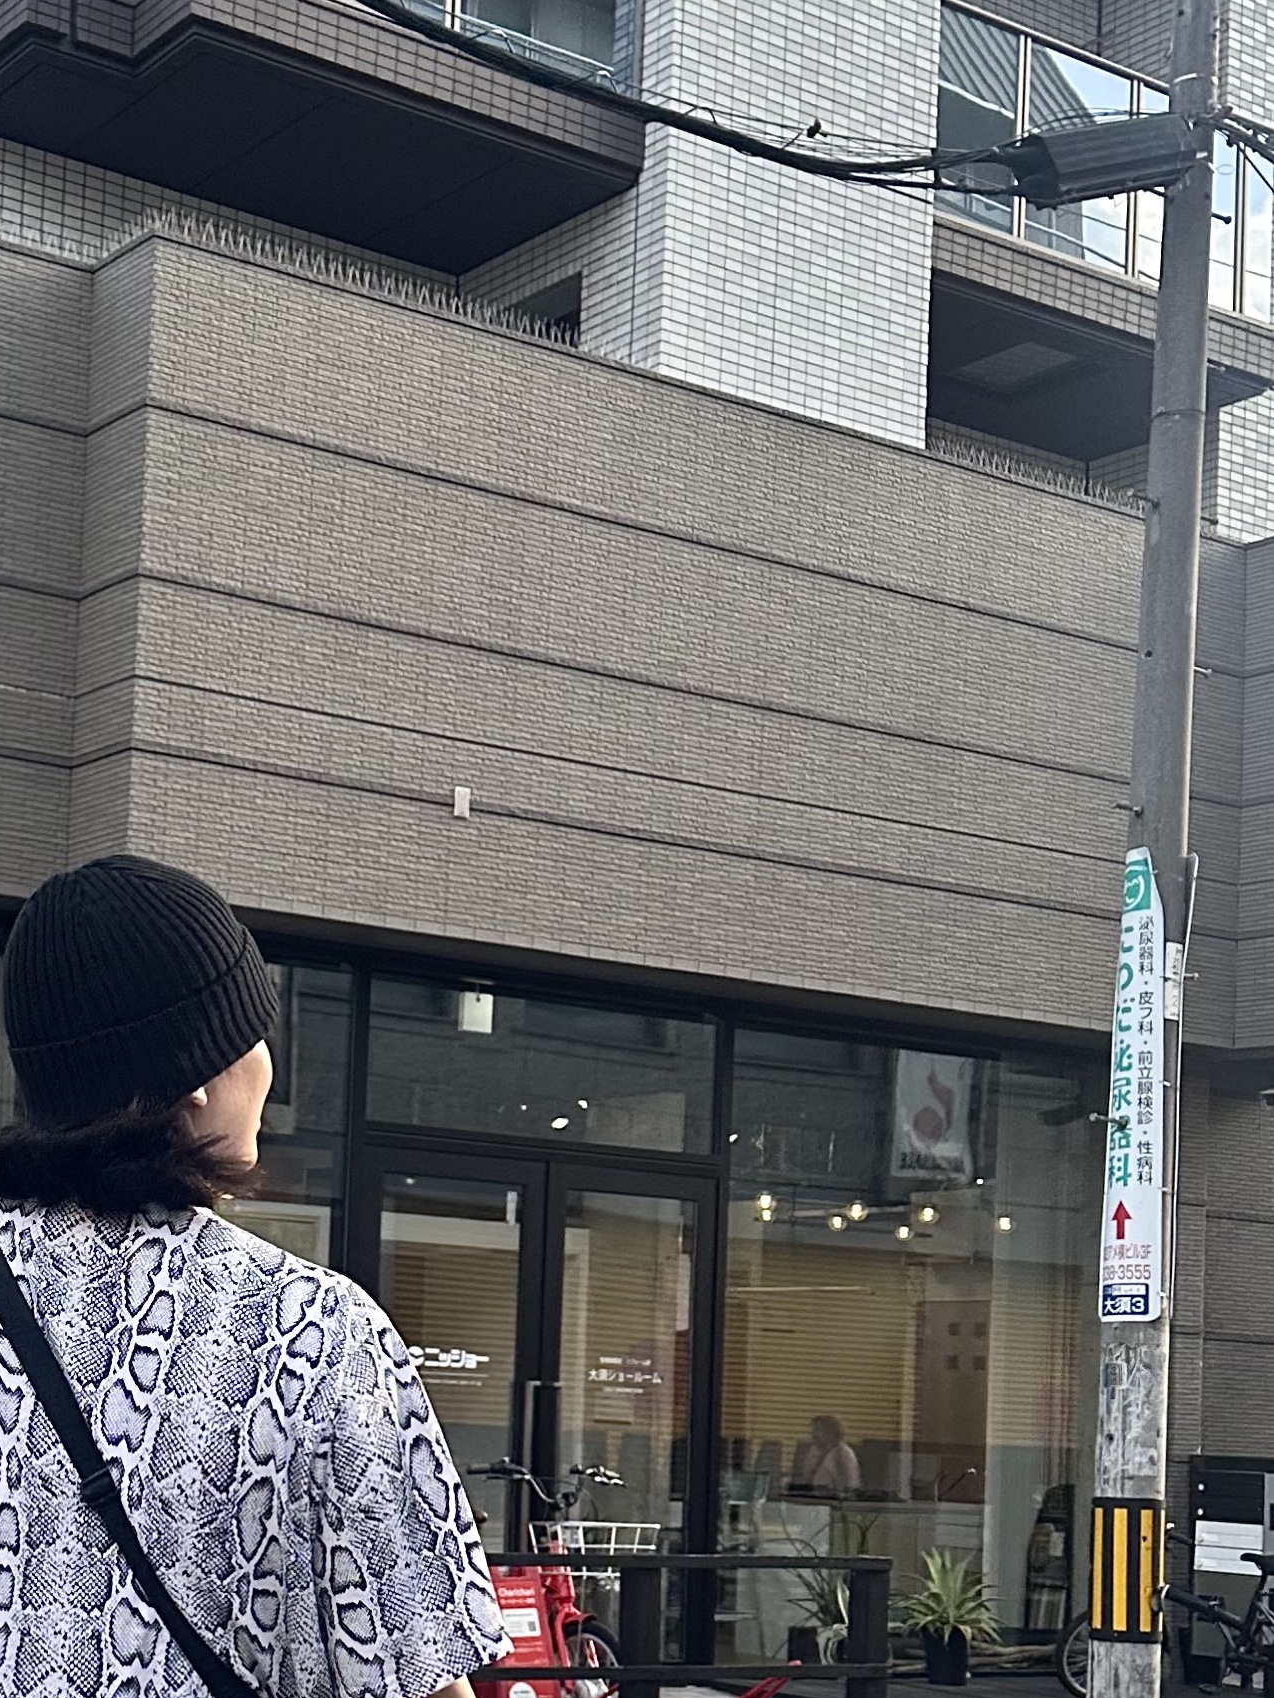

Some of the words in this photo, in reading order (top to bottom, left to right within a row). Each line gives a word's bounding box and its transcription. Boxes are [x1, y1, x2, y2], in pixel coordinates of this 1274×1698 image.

[1103, 1296, 1145, 1314] 大須3
[424, 1347, 490, 1369] ニッショー
